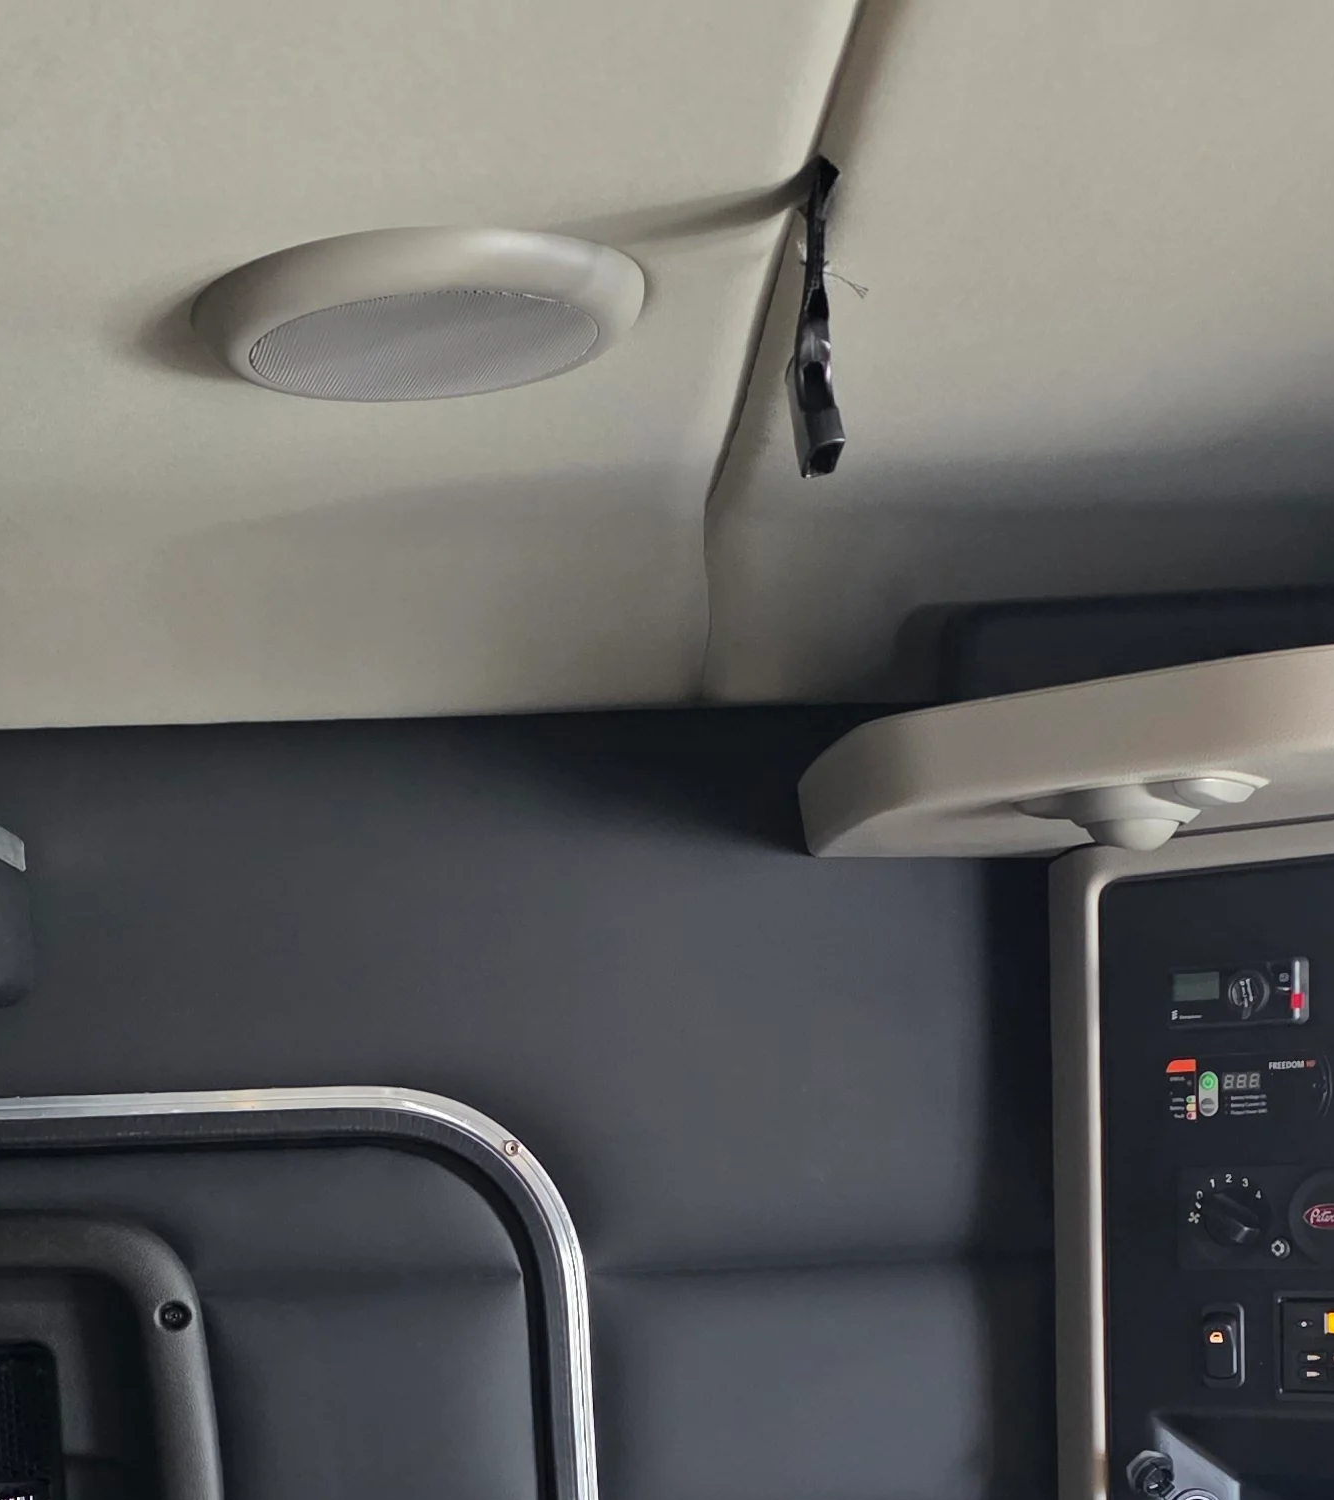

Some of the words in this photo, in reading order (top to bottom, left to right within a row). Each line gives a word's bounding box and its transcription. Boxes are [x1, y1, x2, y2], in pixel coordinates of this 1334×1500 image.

[1268, 1060, 1305, 1070] FREEDOM
[1225, 1173, 1233, 1183] 2
[1242, 1178, 1249, 1187] 3
[1255, 1190, 1262, 1199] 4
